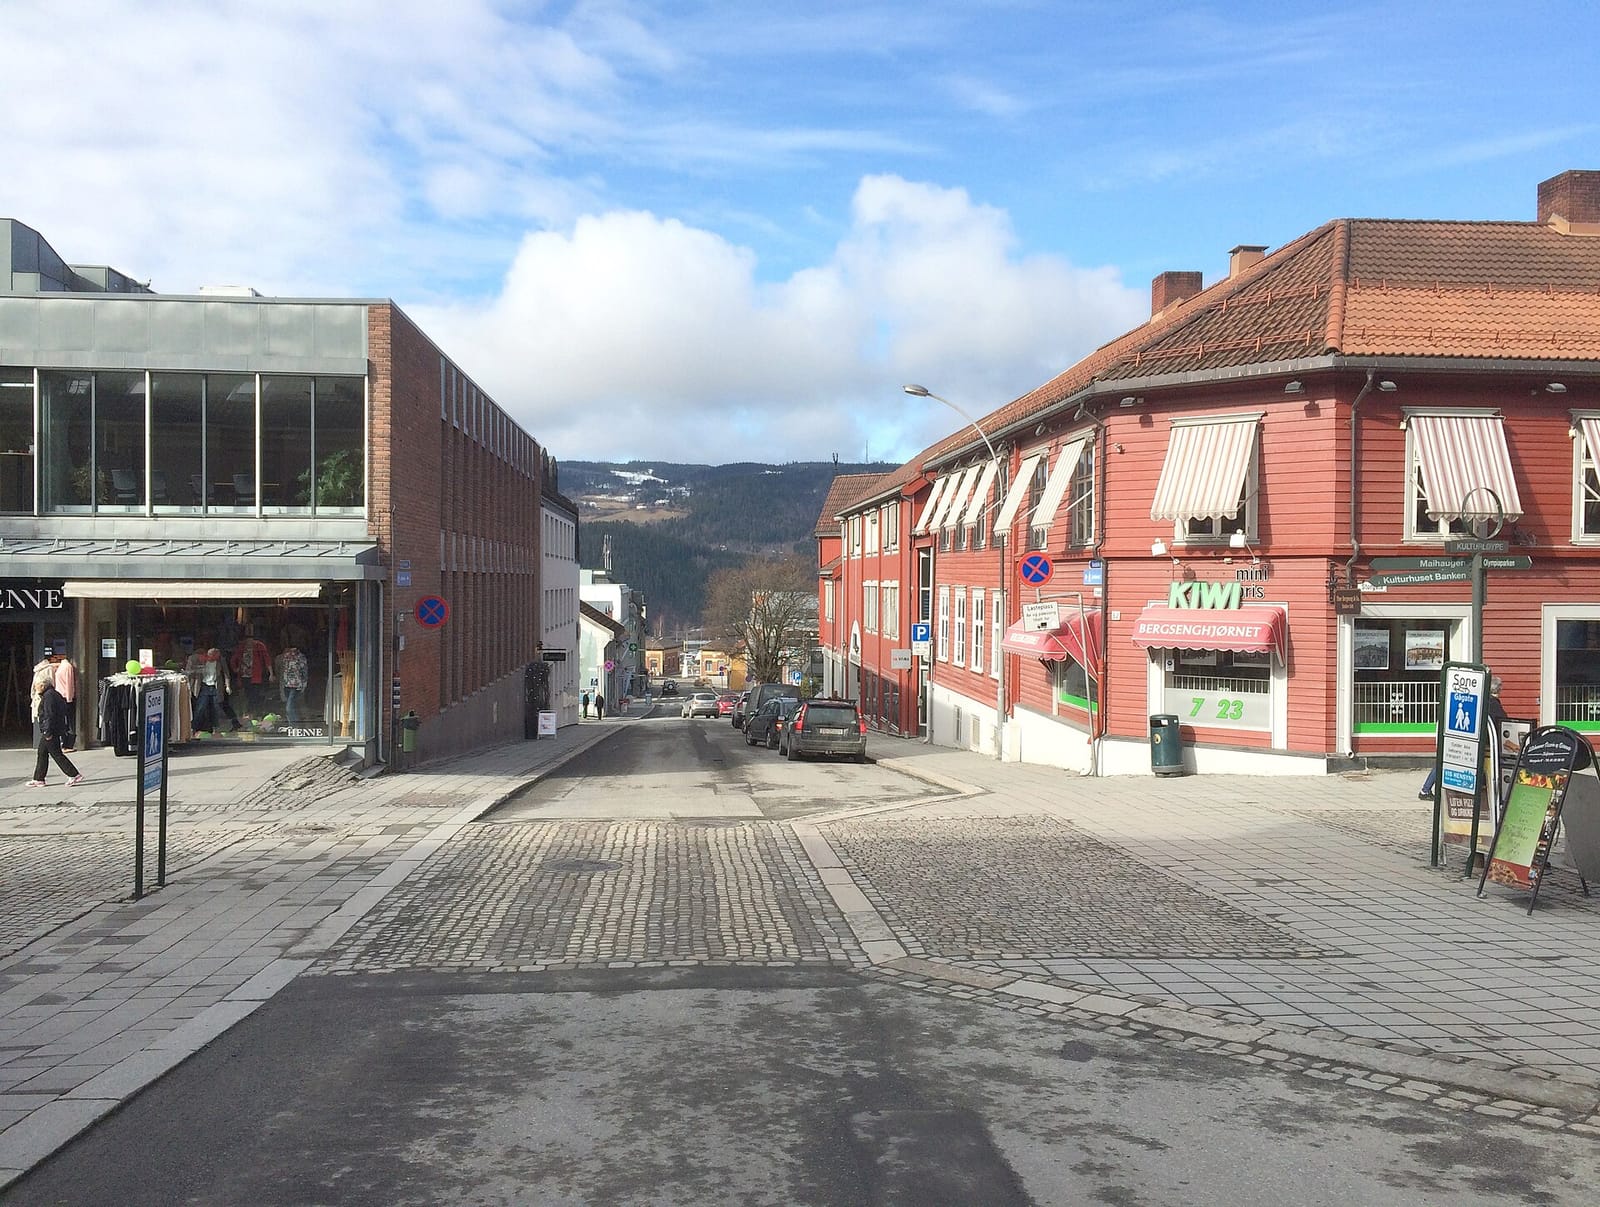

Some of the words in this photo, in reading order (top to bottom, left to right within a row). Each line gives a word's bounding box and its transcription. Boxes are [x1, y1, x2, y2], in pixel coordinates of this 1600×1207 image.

[1419, 558, 1466, 569] Maihaugen
[1236, 565, 1269, 581] mini
[1383, 574, 1434, 584] Kulturhuset
[1435, 572, 1467, 582] Banken
[0, 589, 63, 609] NNE
[1168, 581, 1241, 609] KIWI
[916, 626, 927, 641] P
[1138, 623, 1261, 638] BERGSENGHJØRNET
[1453, 673, 1477, 688] Sone
[1189, 697, 1205, 717] 7
[1216, 699, 1244, 720] 23
[287, 727, 323, 737] HENNE
